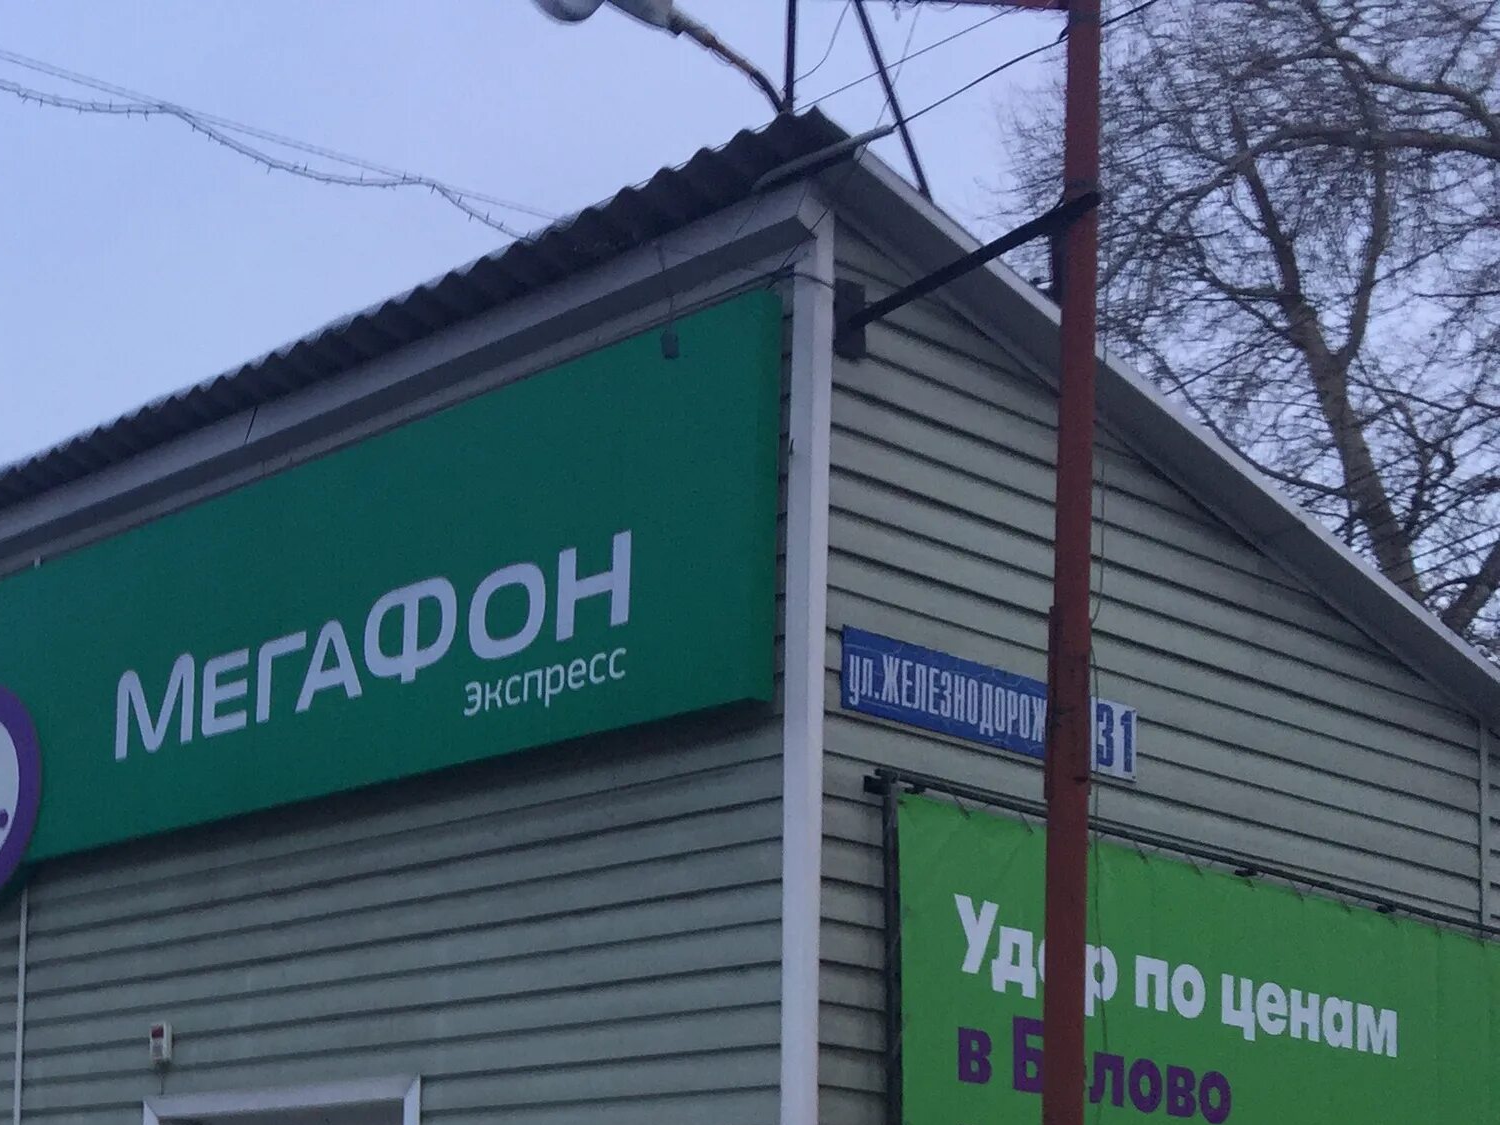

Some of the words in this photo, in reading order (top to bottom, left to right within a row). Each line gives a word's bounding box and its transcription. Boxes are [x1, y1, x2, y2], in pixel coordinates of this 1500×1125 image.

[115, 529, 633, 761] МЕГАФОН
[463, 646, 627, 717] экспресс
[1095, 701, 1133, 773] 31
[954, 893, 1118, 1017] Удр
[1135, 955, 1206, 1019] по
[1221, 973, 1398, 1058] ценам
[958, 1026, 992, 1085] в
[1013, 1015, 1232, 1125] Блово
